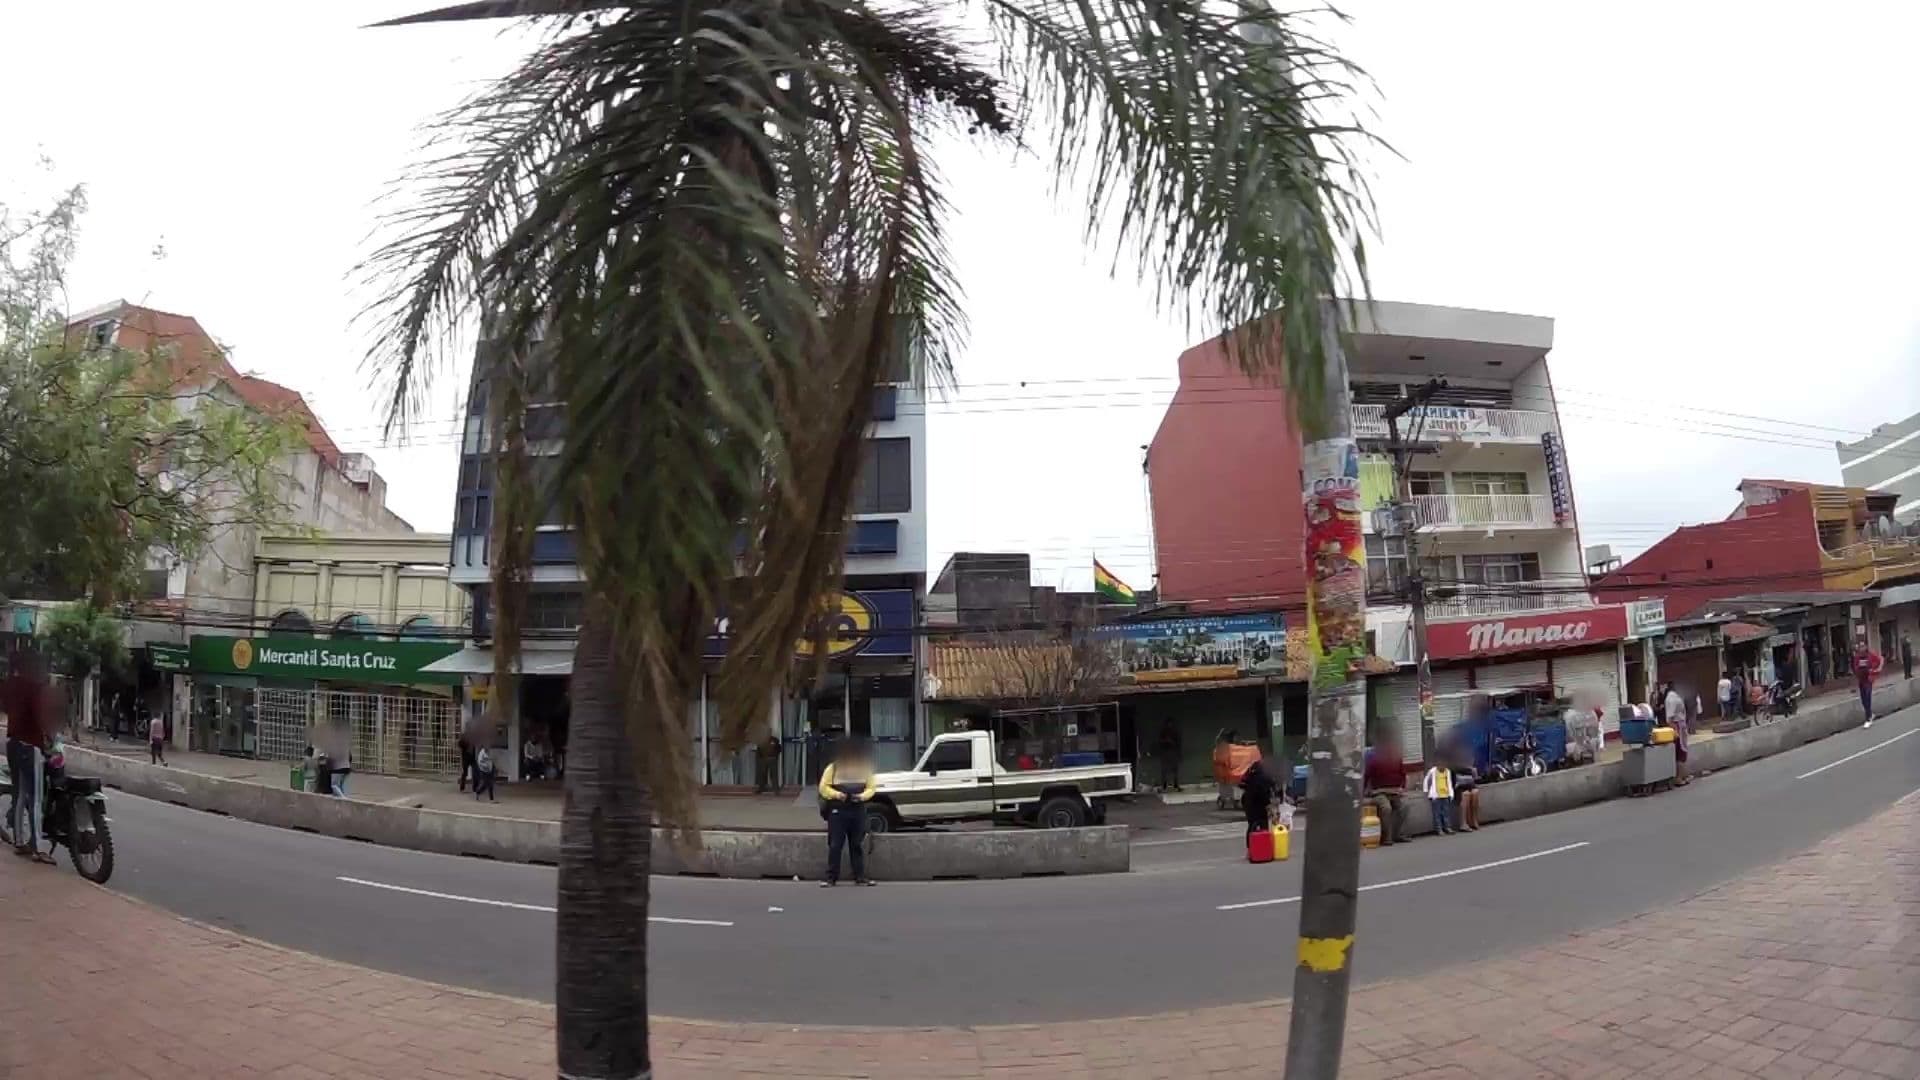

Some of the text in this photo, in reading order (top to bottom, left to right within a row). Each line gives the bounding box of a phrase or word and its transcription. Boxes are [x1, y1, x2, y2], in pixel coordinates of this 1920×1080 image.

[1466, 621, 1588, 652] Manaco
[259, 647, 397, 670] Mercantil Santa Cruz
